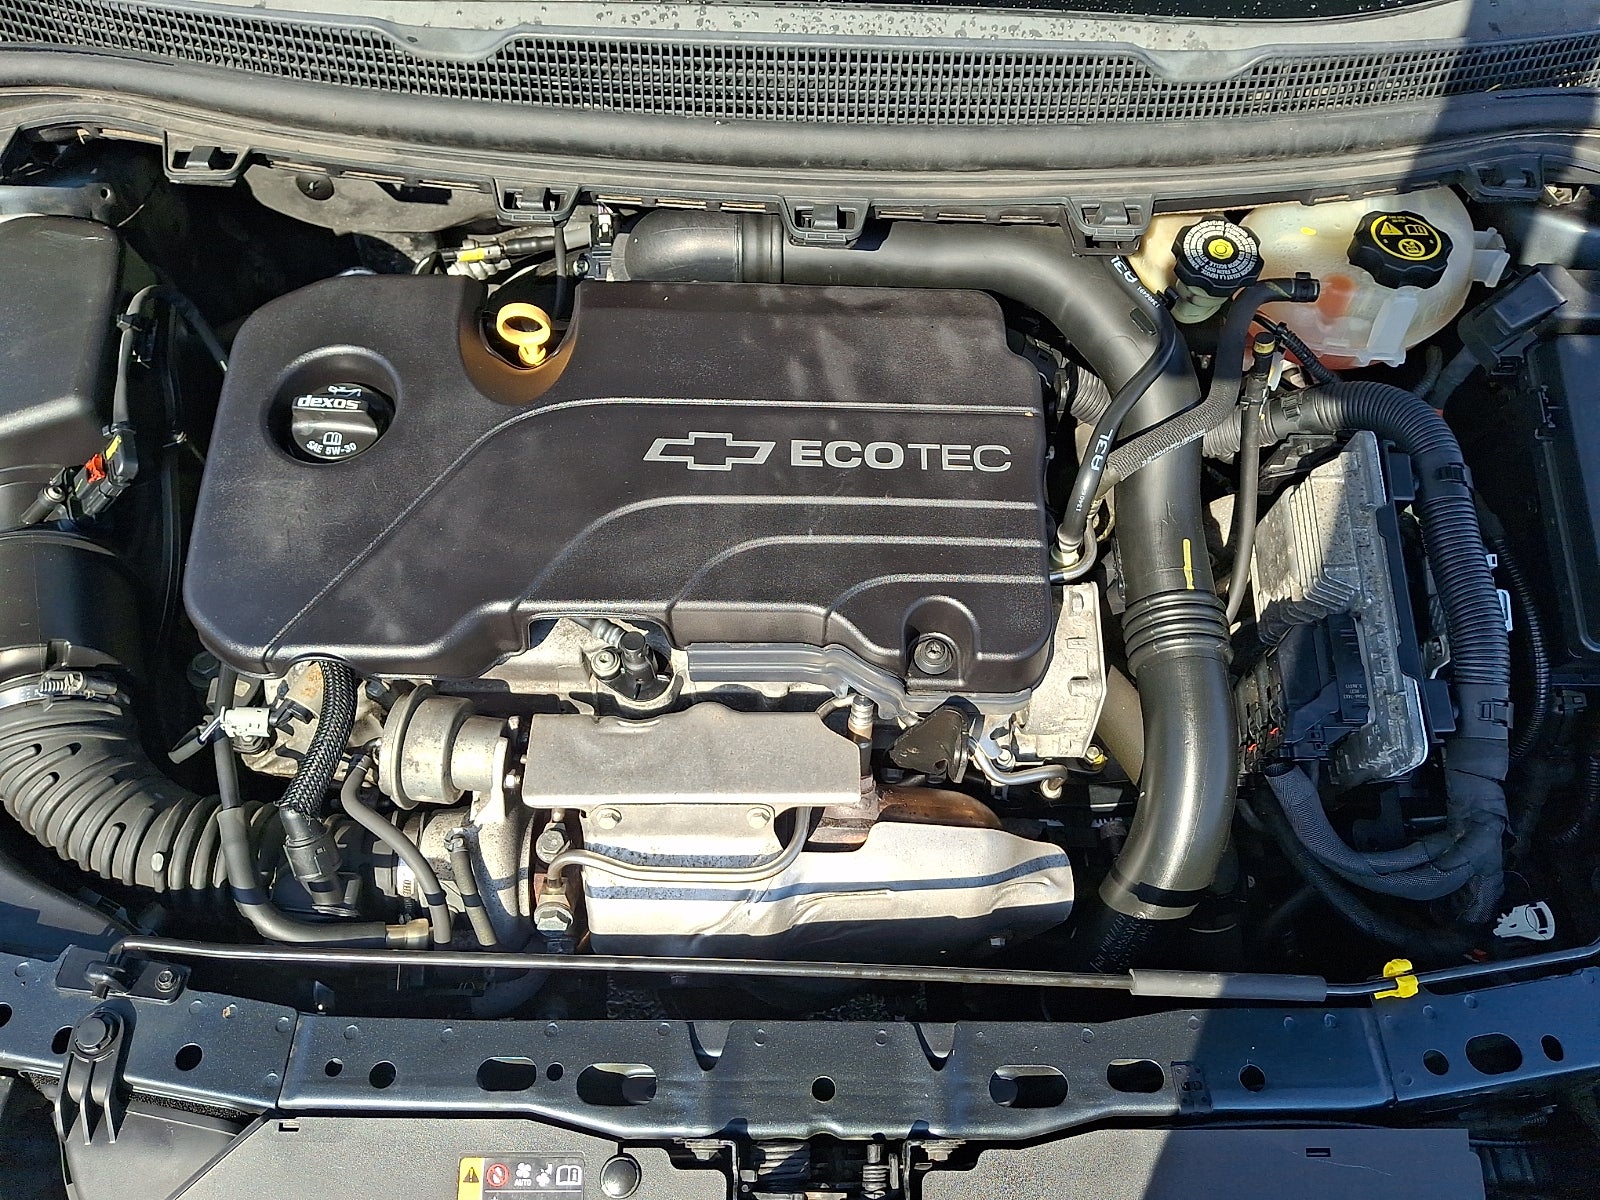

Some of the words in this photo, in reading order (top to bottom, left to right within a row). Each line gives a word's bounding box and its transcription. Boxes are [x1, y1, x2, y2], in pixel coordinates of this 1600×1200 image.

[297, 395, 361, 410] dexos
[306, 440, 324, 453] SAE
[325, 442, 357, 455] 5W-30
[1090, 429, 1114, 471] A3L
[790, 439, 1012, 472] ECOTEC
[514, 1178, 532, 1187] AUTO
